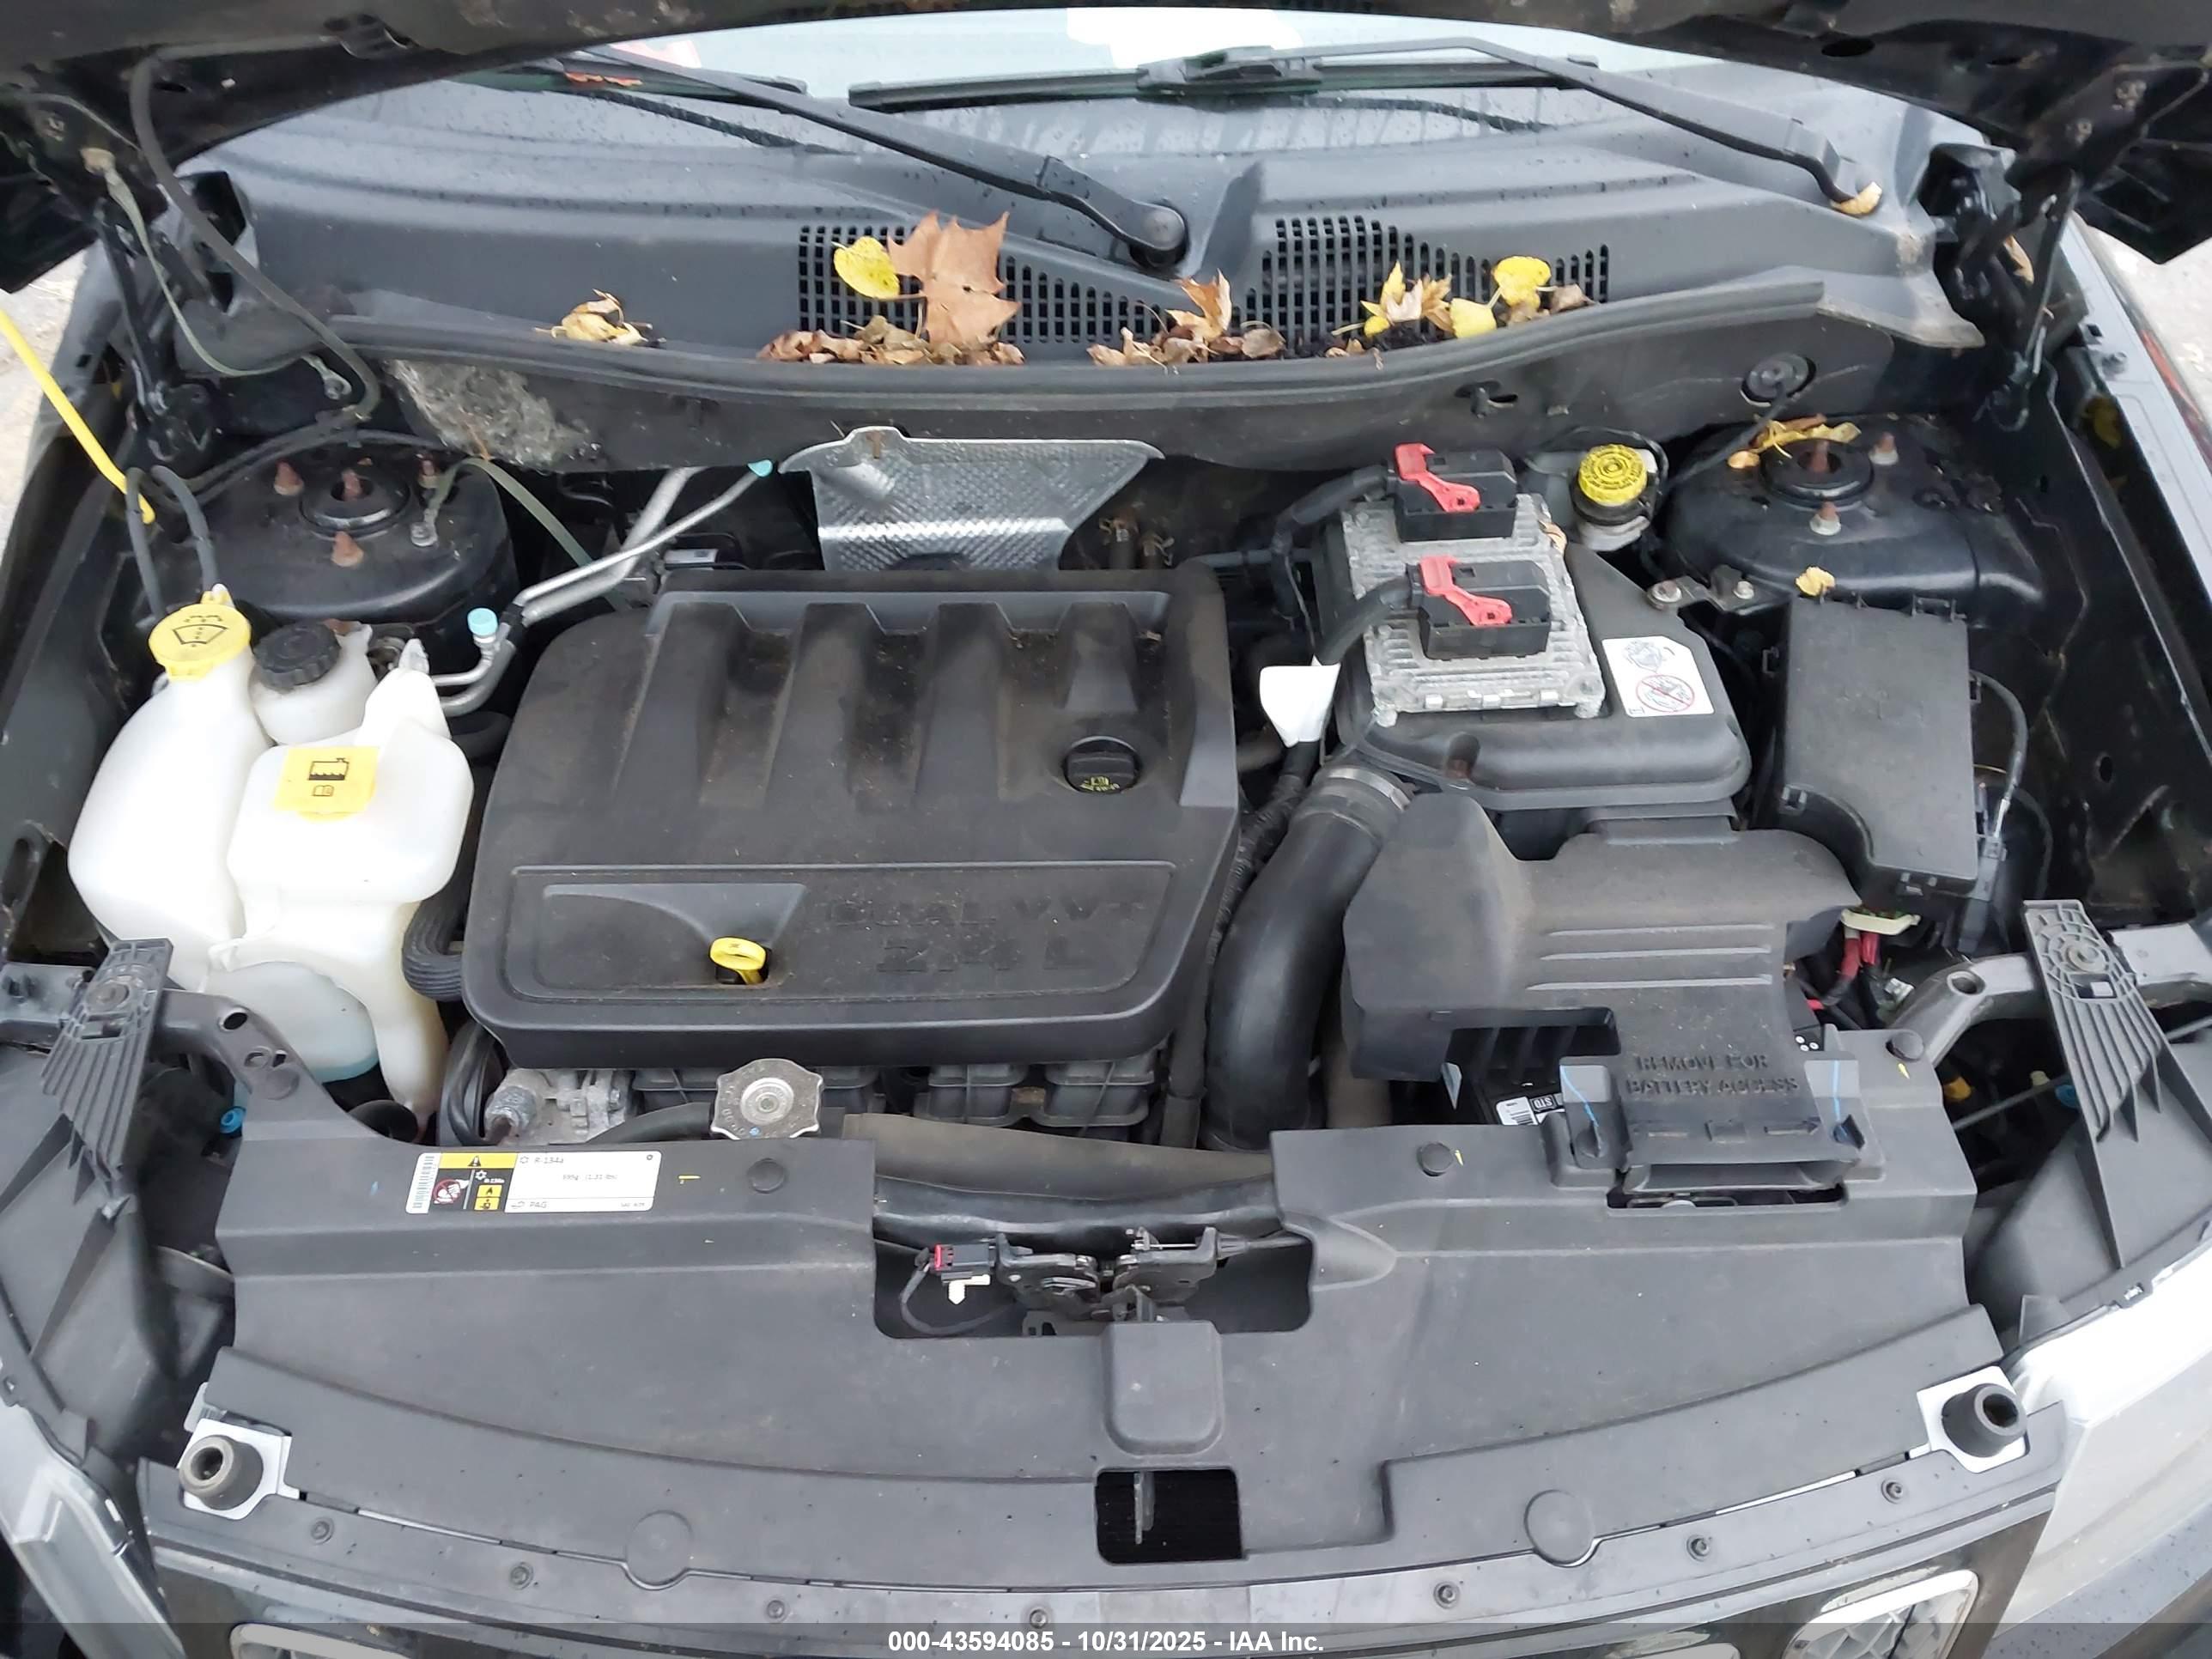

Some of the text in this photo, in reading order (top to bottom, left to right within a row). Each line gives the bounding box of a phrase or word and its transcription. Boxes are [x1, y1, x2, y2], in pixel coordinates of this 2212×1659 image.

[1637, 1054, 1769, 1071] REMOVE FOR
[1626, 1077, 1798, 1095] BATTERY ACCESS
